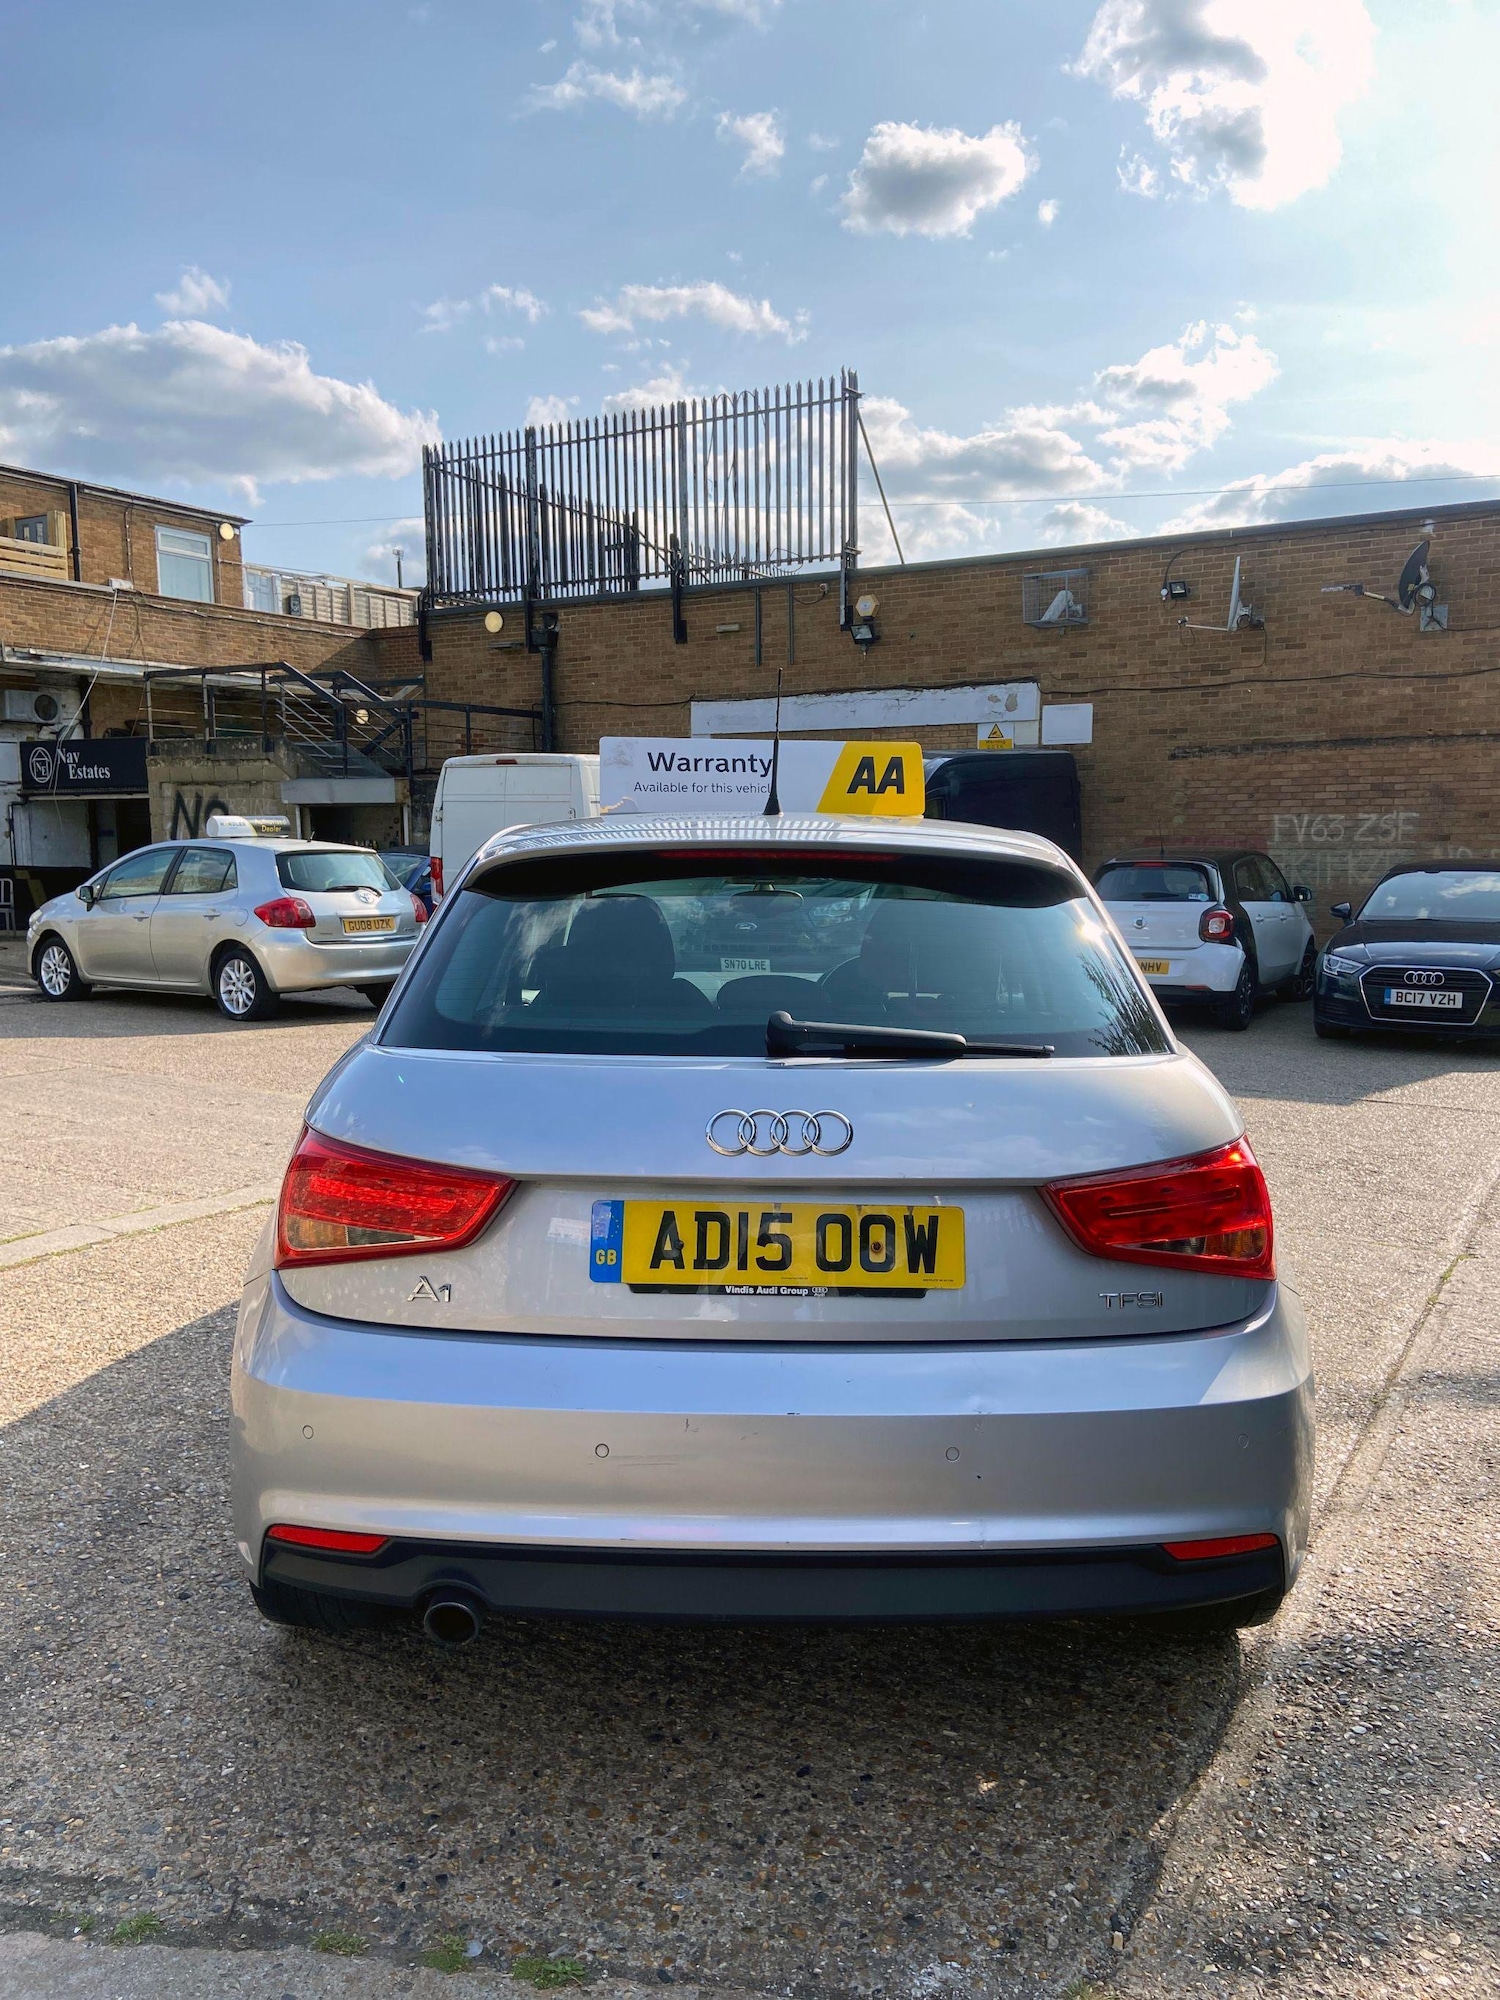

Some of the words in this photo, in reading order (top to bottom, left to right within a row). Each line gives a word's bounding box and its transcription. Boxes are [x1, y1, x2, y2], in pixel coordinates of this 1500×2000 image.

[57, 748, 80, 764] Nav
[68, 763, 111, 779] Estates
[647, 752, 773, 777] Warranty
[847, 756, 905, 794] AA
[633, 782, 688, 793] Available
[692, 782, 709, 793] for
[711, 782, 733, 793] this
[735, 783, 772, 794] vehicl
[261, 825, 282, 833] Dealer
[1273, 814, 1346, 842] FV63
[348, 919, 372, 931] GU08
[374, 918, 392, 930] UZK
[724, 959, 747, 970] SN70
[748, 960, 767, 970] LRE
[1395, 991, 1425, 1004] BC17
[1430, 993, 1456, 1006] VZH
[649, 1210, 793, 1271] AD15
[595, 1249, 617, 1265] GB
[407, 1275, 452, 1302] A1
[725, 1285, 754, 1295] Vindis
[756, 1286, 778, 1295] Audi
[779, 1286, 809, 1297] Group
[1098, 1291, 1163, 1309] TFSI
